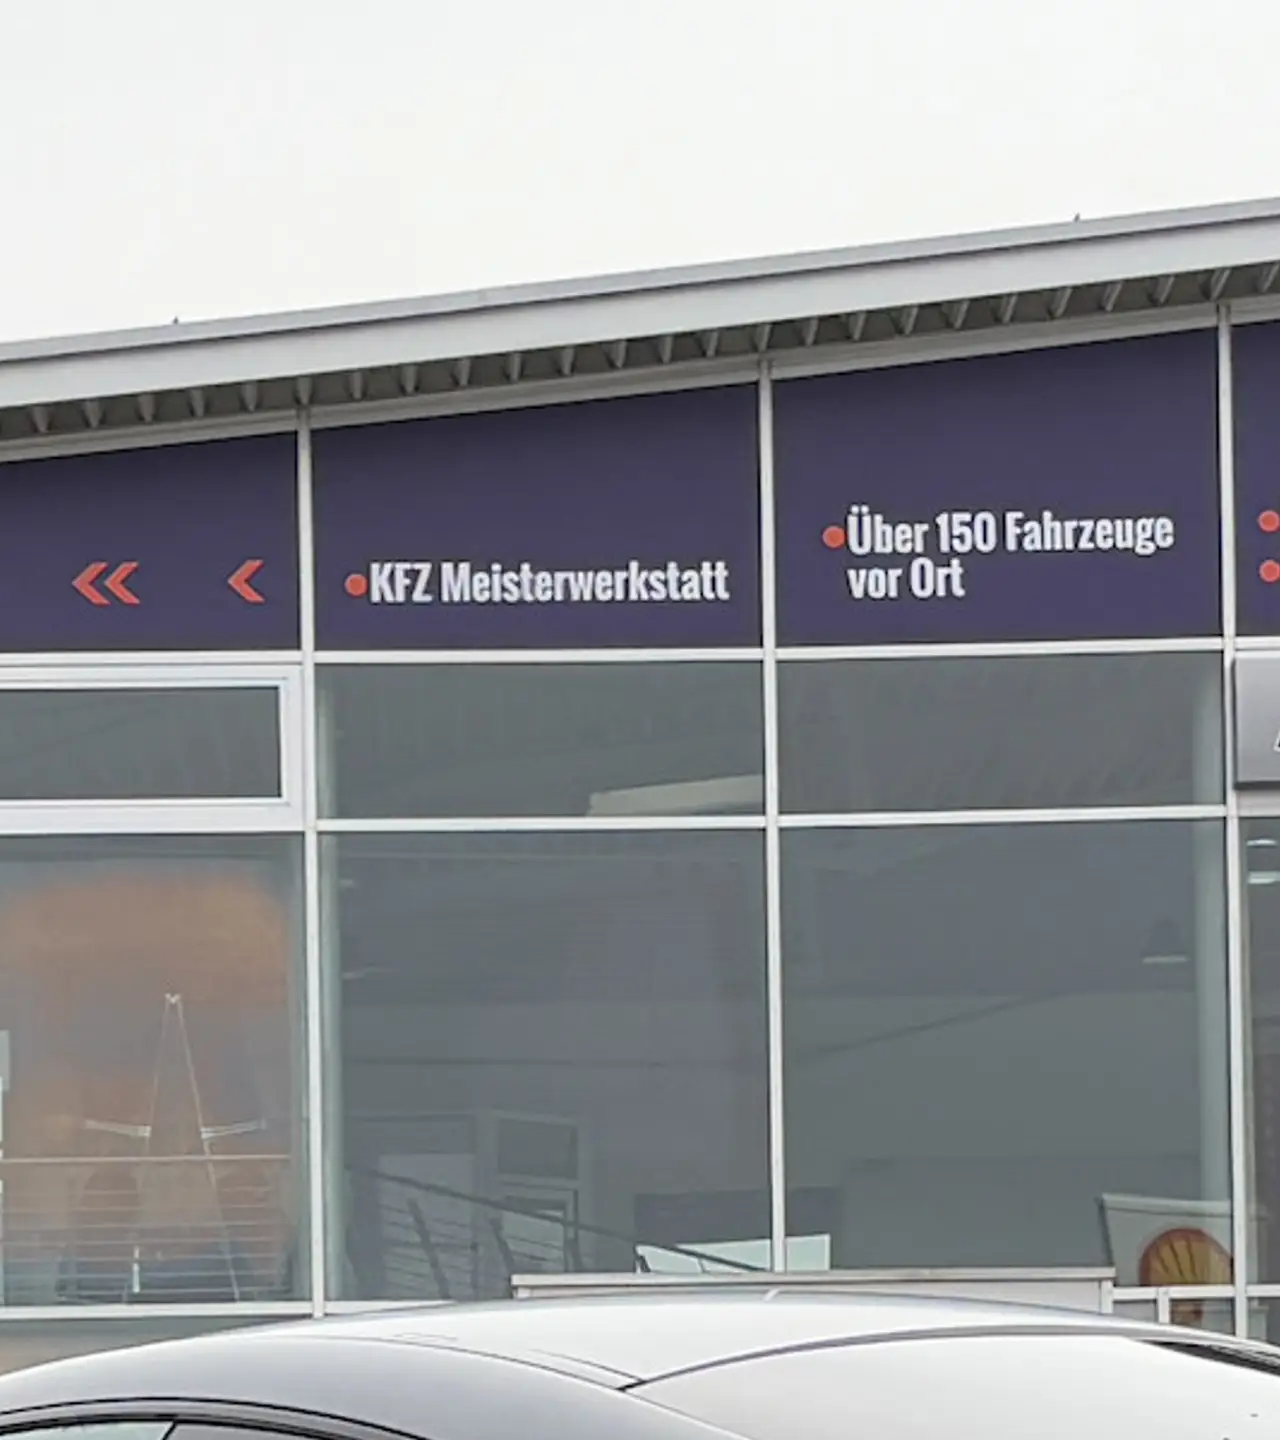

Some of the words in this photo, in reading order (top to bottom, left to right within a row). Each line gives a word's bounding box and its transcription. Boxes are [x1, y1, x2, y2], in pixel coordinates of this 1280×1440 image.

[846, 504, 931, 556] Über
[935, 510, 998, 554] 150
[1005, 509, 1176, 558] Fahrzeuge
[369, 561, 434, 604] KFZ
[440, 559, 731, 604] Meisterwerkstatt
[847, 566, 903, 600] vor
[910, 556, 967, 599] Ort
